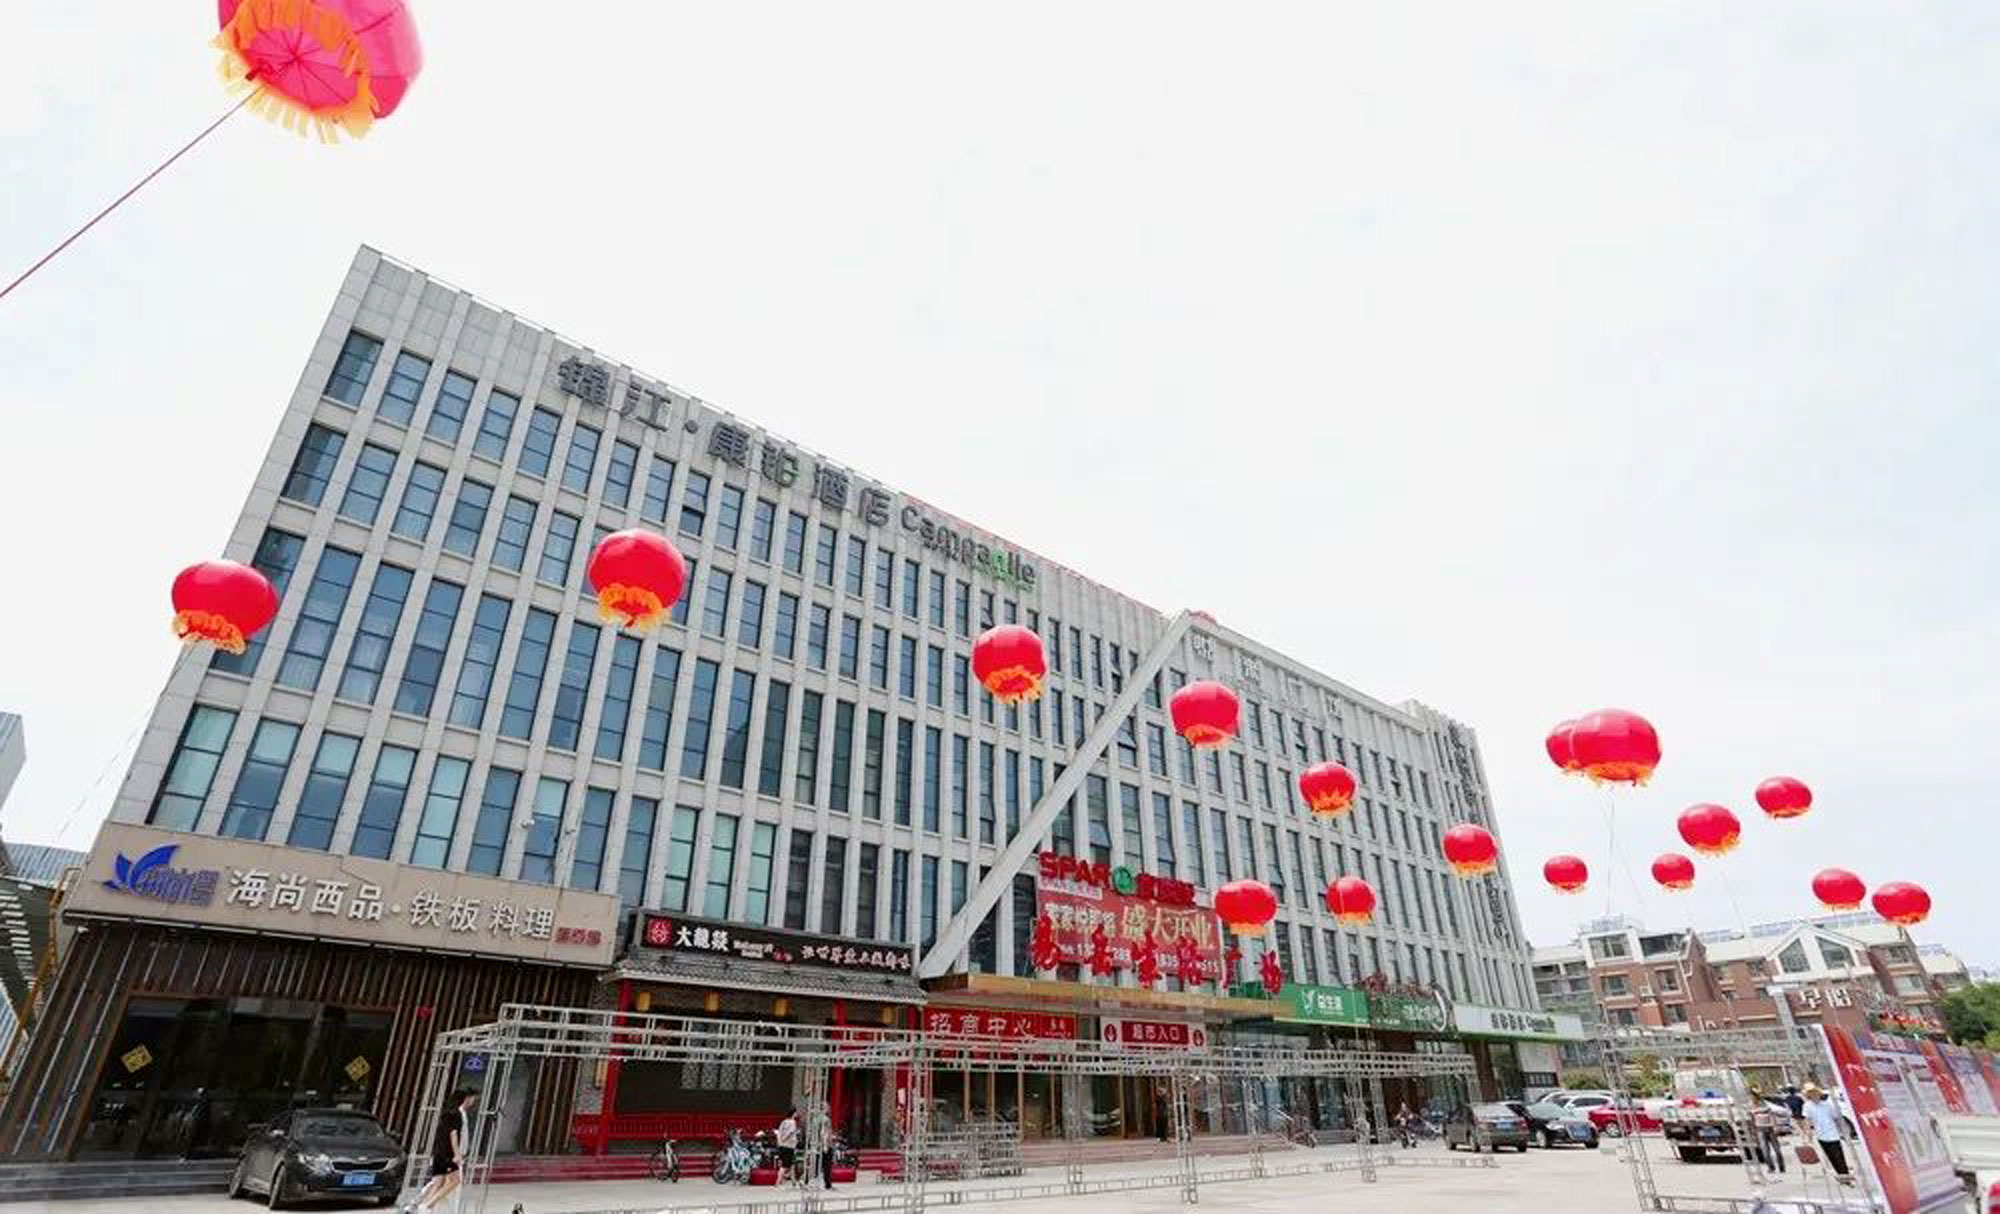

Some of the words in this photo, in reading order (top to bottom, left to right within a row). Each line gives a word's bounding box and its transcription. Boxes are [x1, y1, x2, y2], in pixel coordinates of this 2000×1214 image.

[1039, 851, 1112, 889] SPAR
[929, 1012, 1036, 1039] 招商中心
[1132, 1023, 1182, 1043] 超市入口
